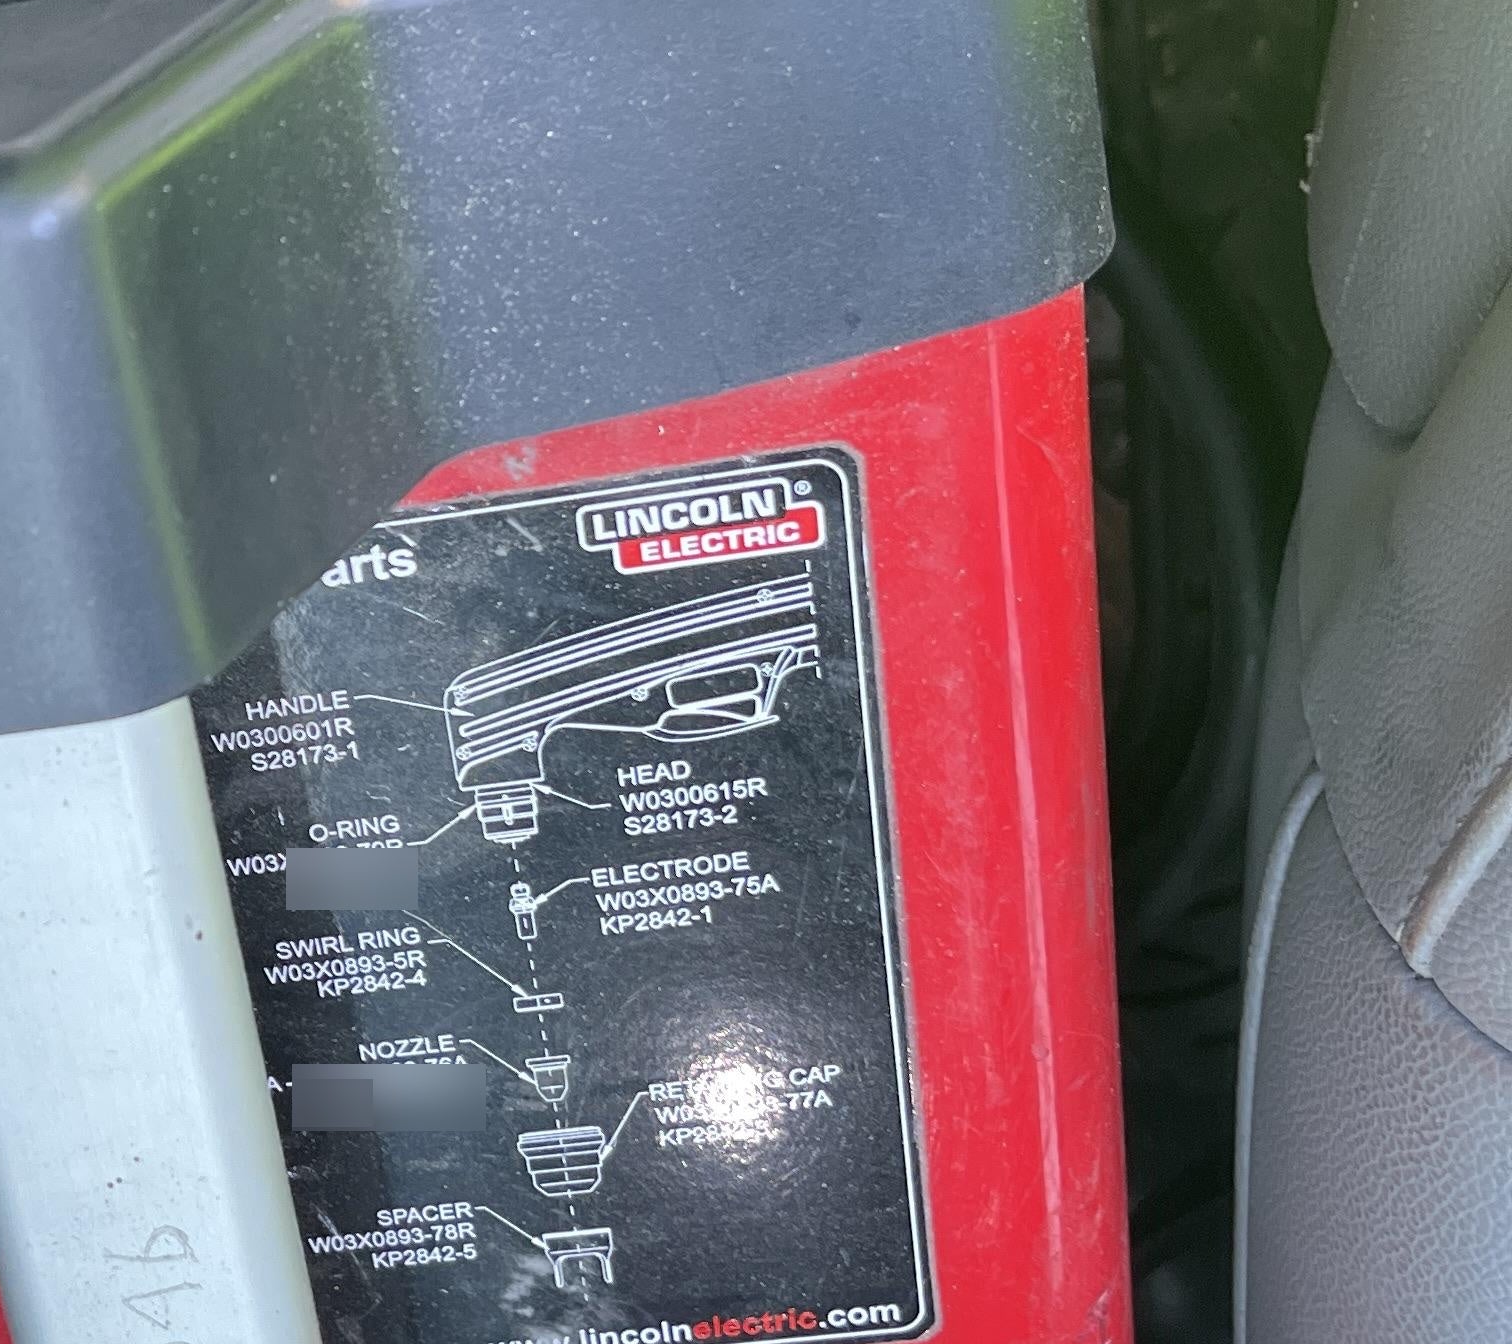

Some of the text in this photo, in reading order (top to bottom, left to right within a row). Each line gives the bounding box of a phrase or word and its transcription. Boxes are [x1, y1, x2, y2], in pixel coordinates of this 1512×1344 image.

[592, 488, 777, 543] LINCOLN
[640, 522, 801, 563] ELECTRIC
[320, 543, 418, 588] arts
[246, 690, 350, 720] HANDLE
[210, 717, 355, 752] W0300601R
[250, 741, 360, 772] S28173-1
[617, 760, 691, 787] HEAD
[619, 777, 768, 812] W0300615R
[309, 815, 400, 842] O-RING
[623, 805, 738, 836] S28173-2
[591, 851, 751, 888] ELECTRODE
[595, 873, 781, 912] W03X0893-75A
[600, 906, 713, 936] KP2842-1
[276, 926, 421, 960] SWIRL RING
[264, 949, 427, 984] W03X0893-5R
[317, 971, 427, 998] KP2842-4
[359, 1034, 455, 1061] NOZZLE
[789, 1064, 840, 1085] CAP
[377, 1201, 475, 1226] SPACER
[308, 1223, 477, 1254] W03X0893-78R
[371, 1243, 477, 1269] KP2842-5
